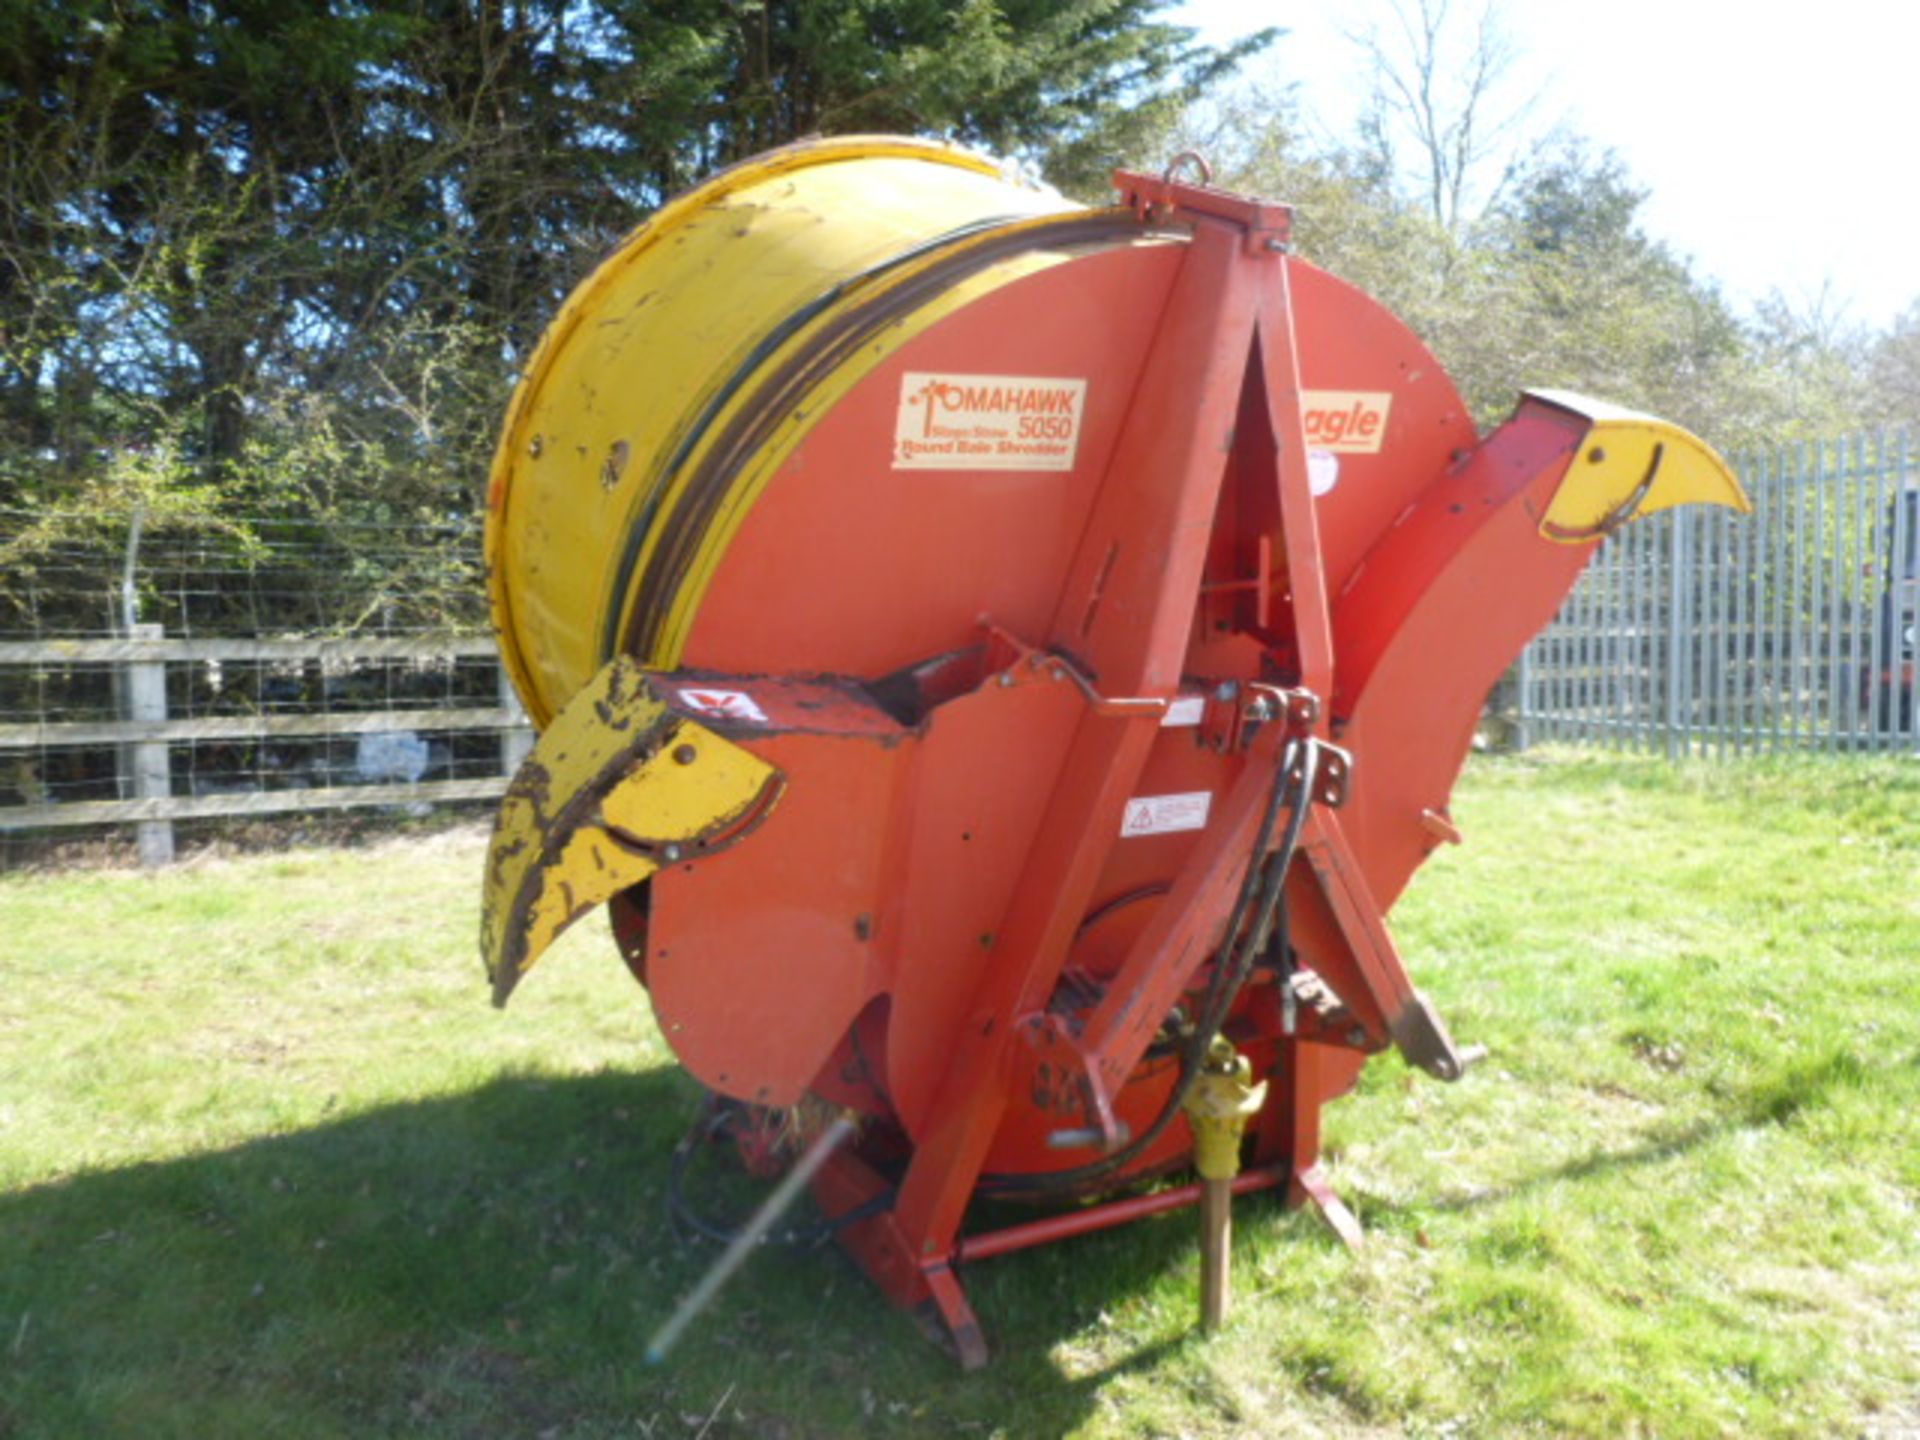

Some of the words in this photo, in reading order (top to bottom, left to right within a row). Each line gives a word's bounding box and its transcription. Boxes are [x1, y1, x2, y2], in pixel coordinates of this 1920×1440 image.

[1018, 416, 1072, 439] 5050
[902, 439, 954, 454] Round
[957, 440, 993, 454] Bale
[997, 440, 1068, 456] Shredder
